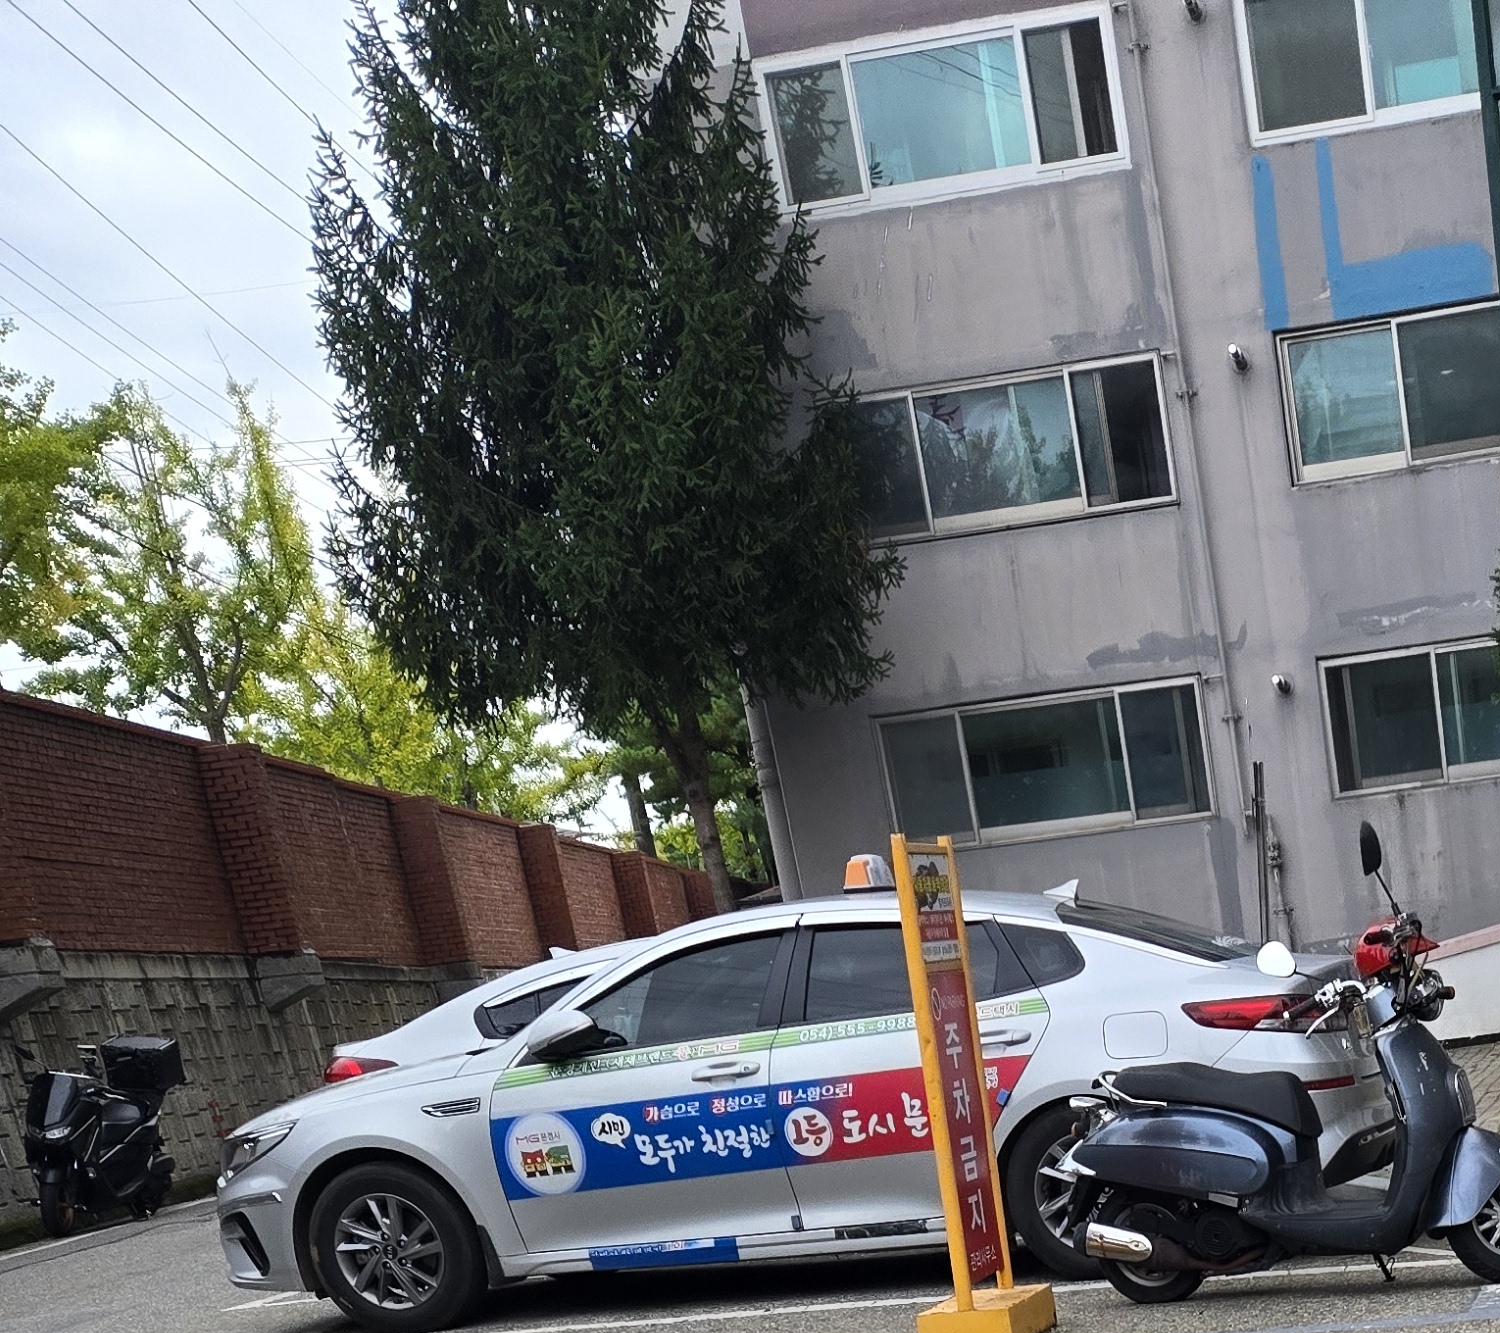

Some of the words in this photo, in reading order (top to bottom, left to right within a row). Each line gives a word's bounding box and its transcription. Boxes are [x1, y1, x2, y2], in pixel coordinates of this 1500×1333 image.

[643, 1101, 700, 1122] 가슴으로
[710, 1093, 767, 1114] 정성으로
[778, 1083, 853, 1105] 따스함으로!
[516, 1134, 540, 1145] MG
[600, 1120, 625, 1136] 시민
[634, 1131, 695, 1174] 모두가
[698, 1125, 771, 1158] 친절한
[791, 1114, 828, 1147] 1등
[842, 1109, 896, 1143] 도시
[901, 1091, 930, 1138] 문
